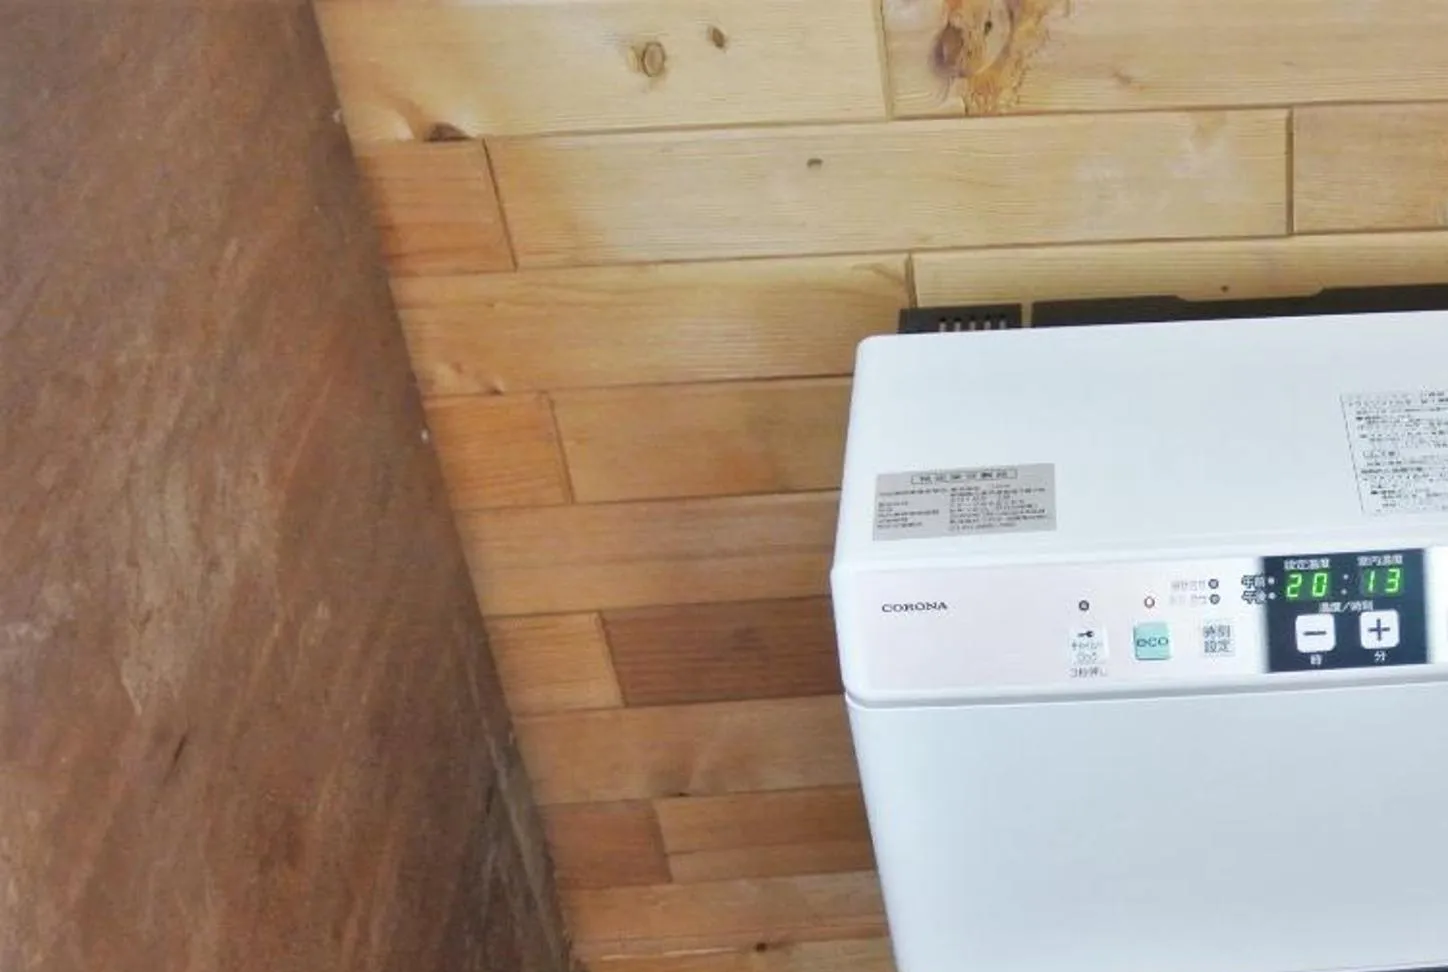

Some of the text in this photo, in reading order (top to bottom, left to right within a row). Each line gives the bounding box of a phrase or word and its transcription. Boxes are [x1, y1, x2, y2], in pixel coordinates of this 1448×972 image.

[1286, 567, 1401, 598] 20 13
[1136, 636, 1169, 648] eco
